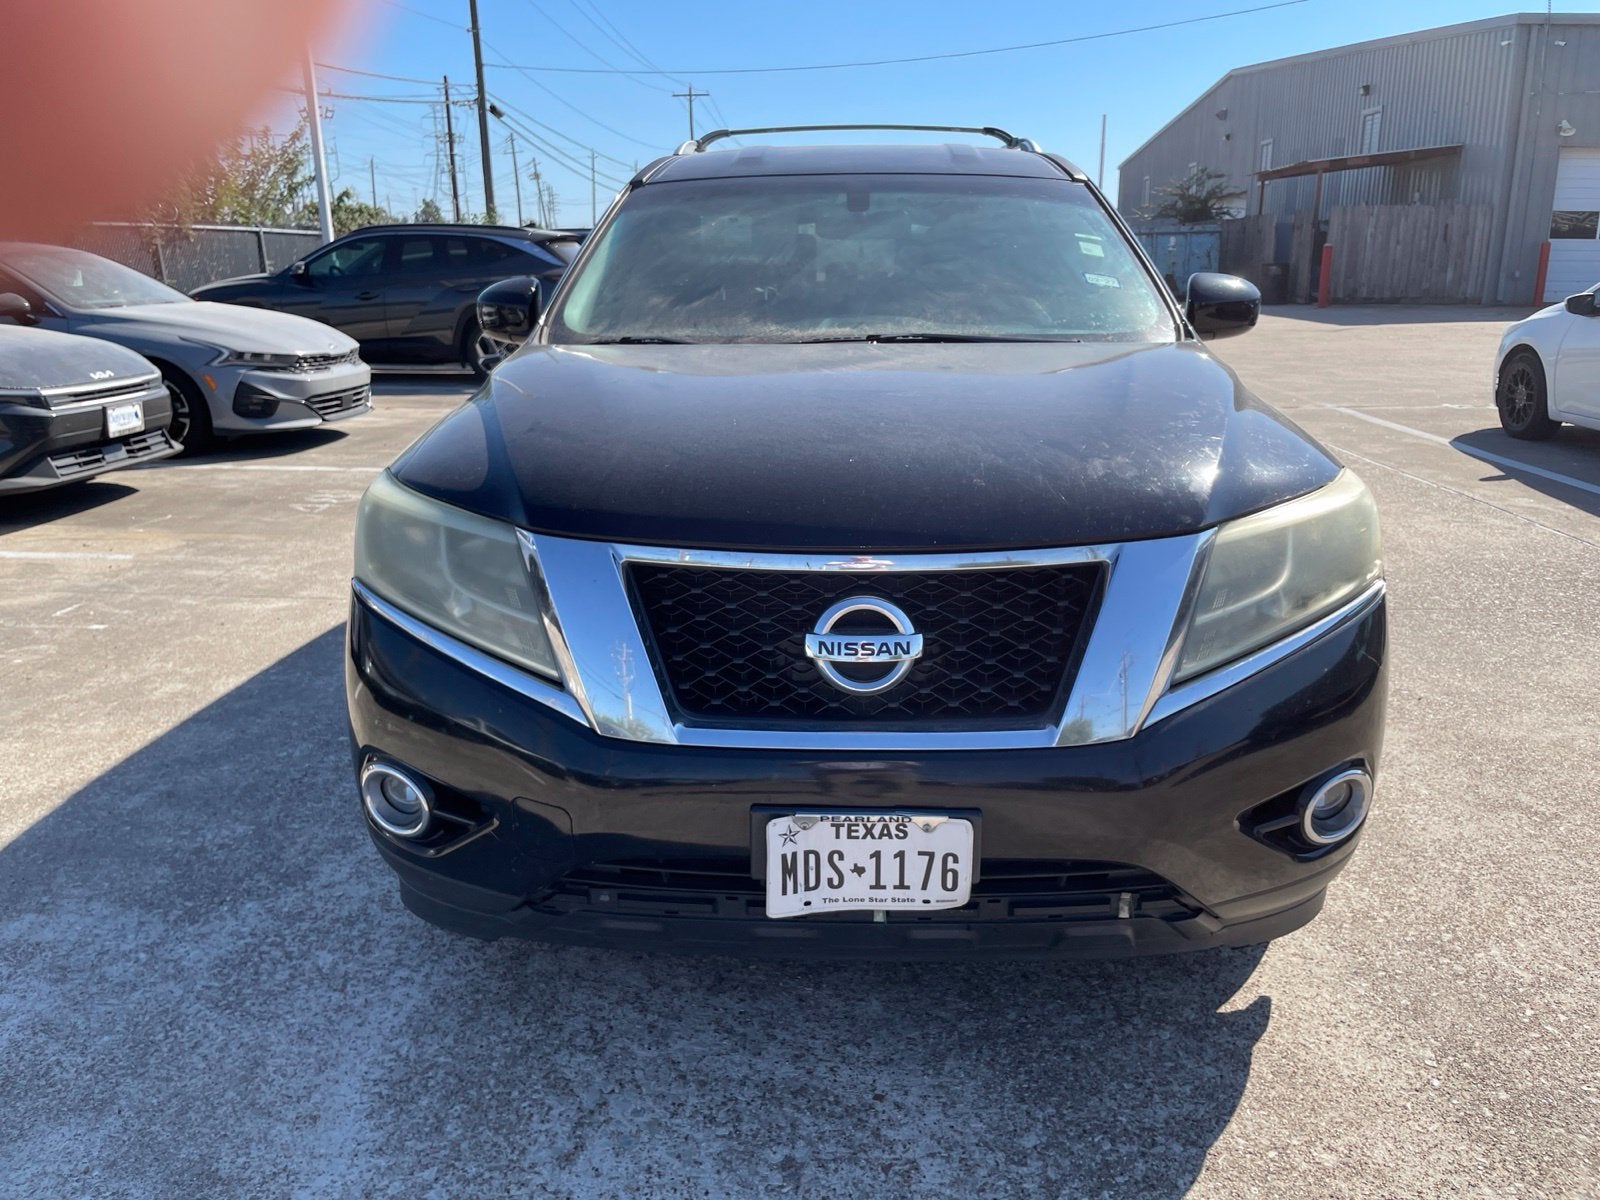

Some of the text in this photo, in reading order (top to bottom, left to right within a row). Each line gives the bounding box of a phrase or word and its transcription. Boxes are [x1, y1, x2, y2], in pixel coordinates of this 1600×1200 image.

[818, 640, 911, 657] NISSAN
[820, 815, 913, 823] PEARLAND
[830, 823, 909, 840] TEXAS
[780, 849, 959, 896] MDS 1176
[822, 896, 840, 904] The
